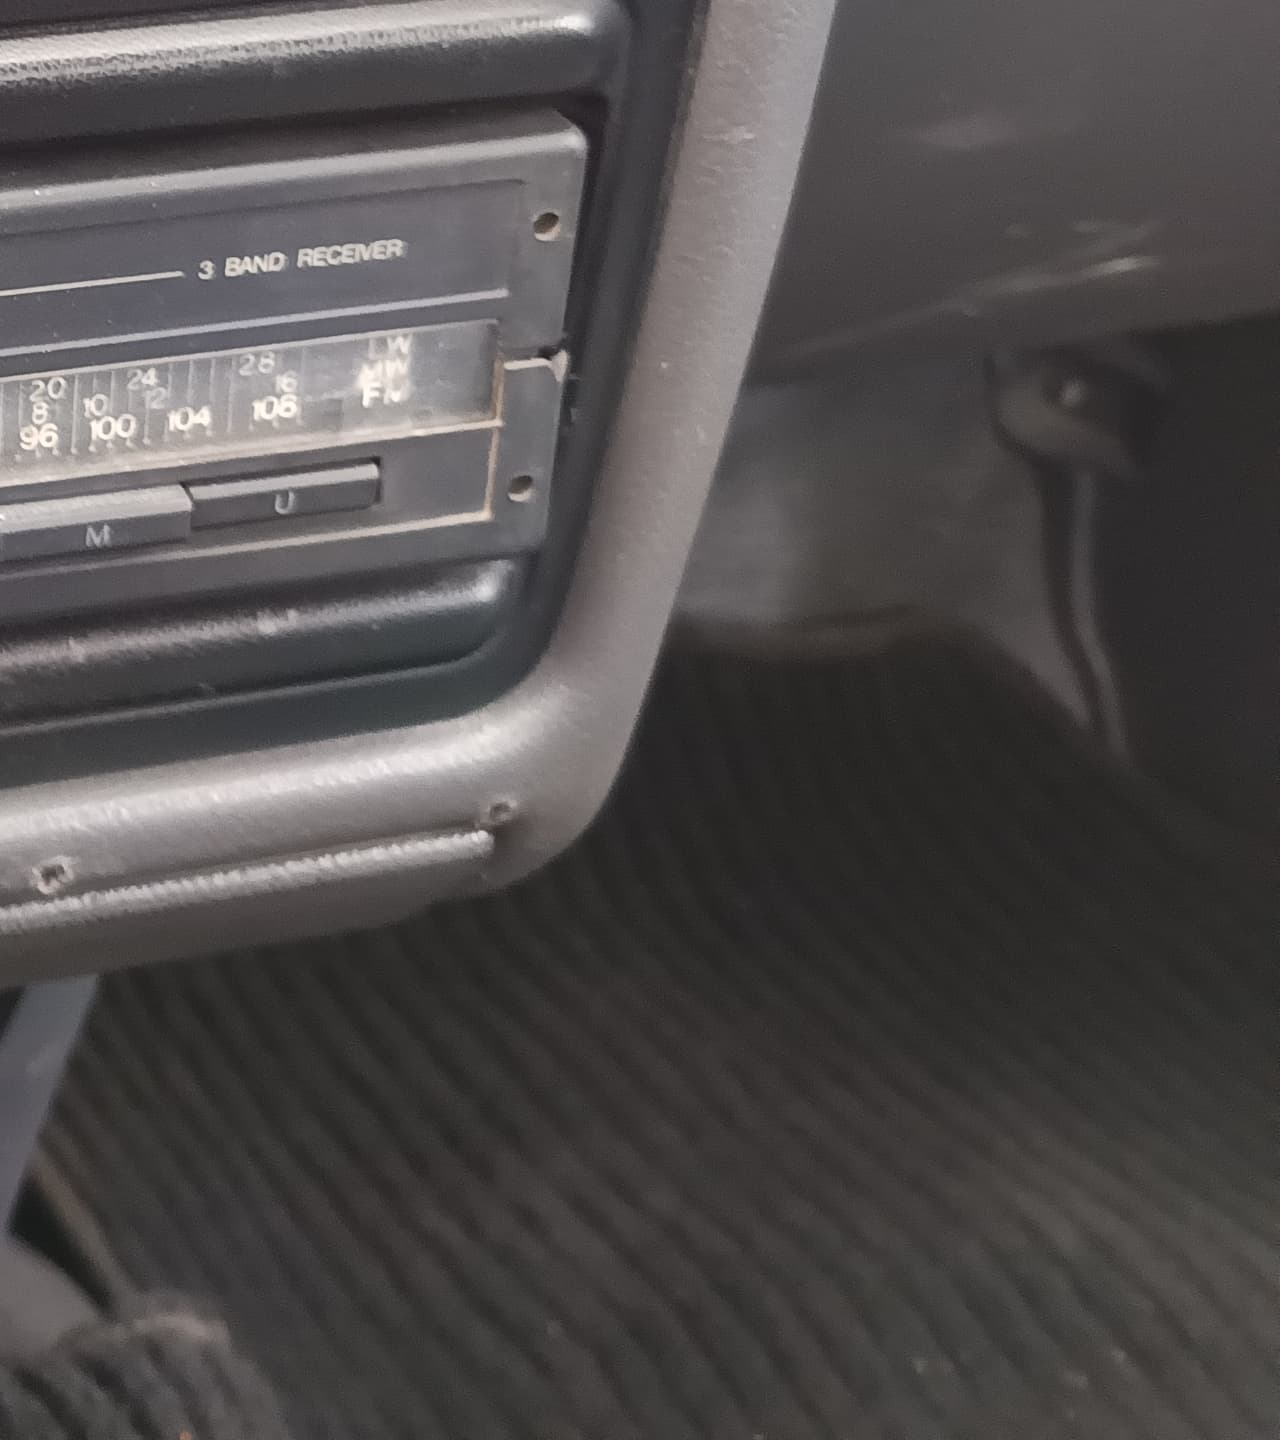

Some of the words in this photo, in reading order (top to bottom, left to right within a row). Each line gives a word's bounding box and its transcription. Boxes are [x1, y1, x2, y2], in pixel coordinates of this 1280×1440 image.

[198, 260, 216, 280] 3
[224, 251, 288, 277] BAND
[297, 239, 408, 268] RECEIVER
[29, 376, 67, 402] 20
[127, 367, 159, 391] 24
[82, 393, 110, 418] 10
[90, 413, 137, 441] 100
[167, 406, 212, 432] 104
[19, 422, 59, 450] 96
[273, 489, 296, 515] U
[85, 524, 113, 549] M
